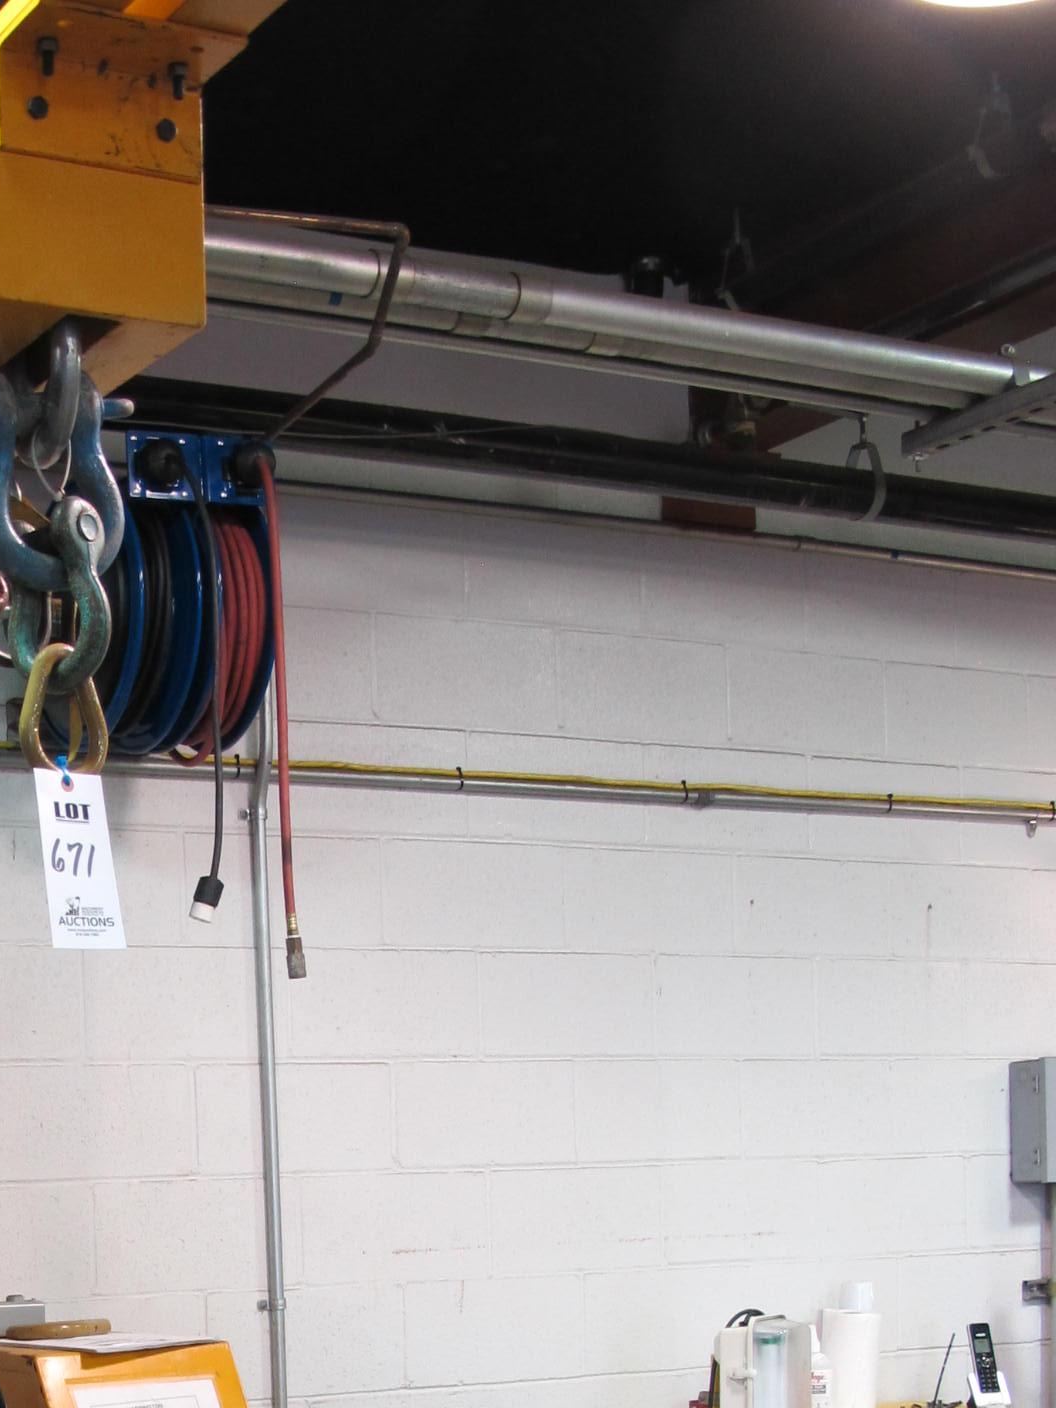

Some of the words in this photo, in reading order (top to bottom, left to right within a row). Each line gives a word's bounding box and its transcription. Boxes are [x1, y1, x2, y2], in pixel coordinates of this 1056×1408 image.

[53, 801, 91, 821] LOT
[51, 838, 96, 878] 671
[58, 916, 115, 928] AUCTIONS
